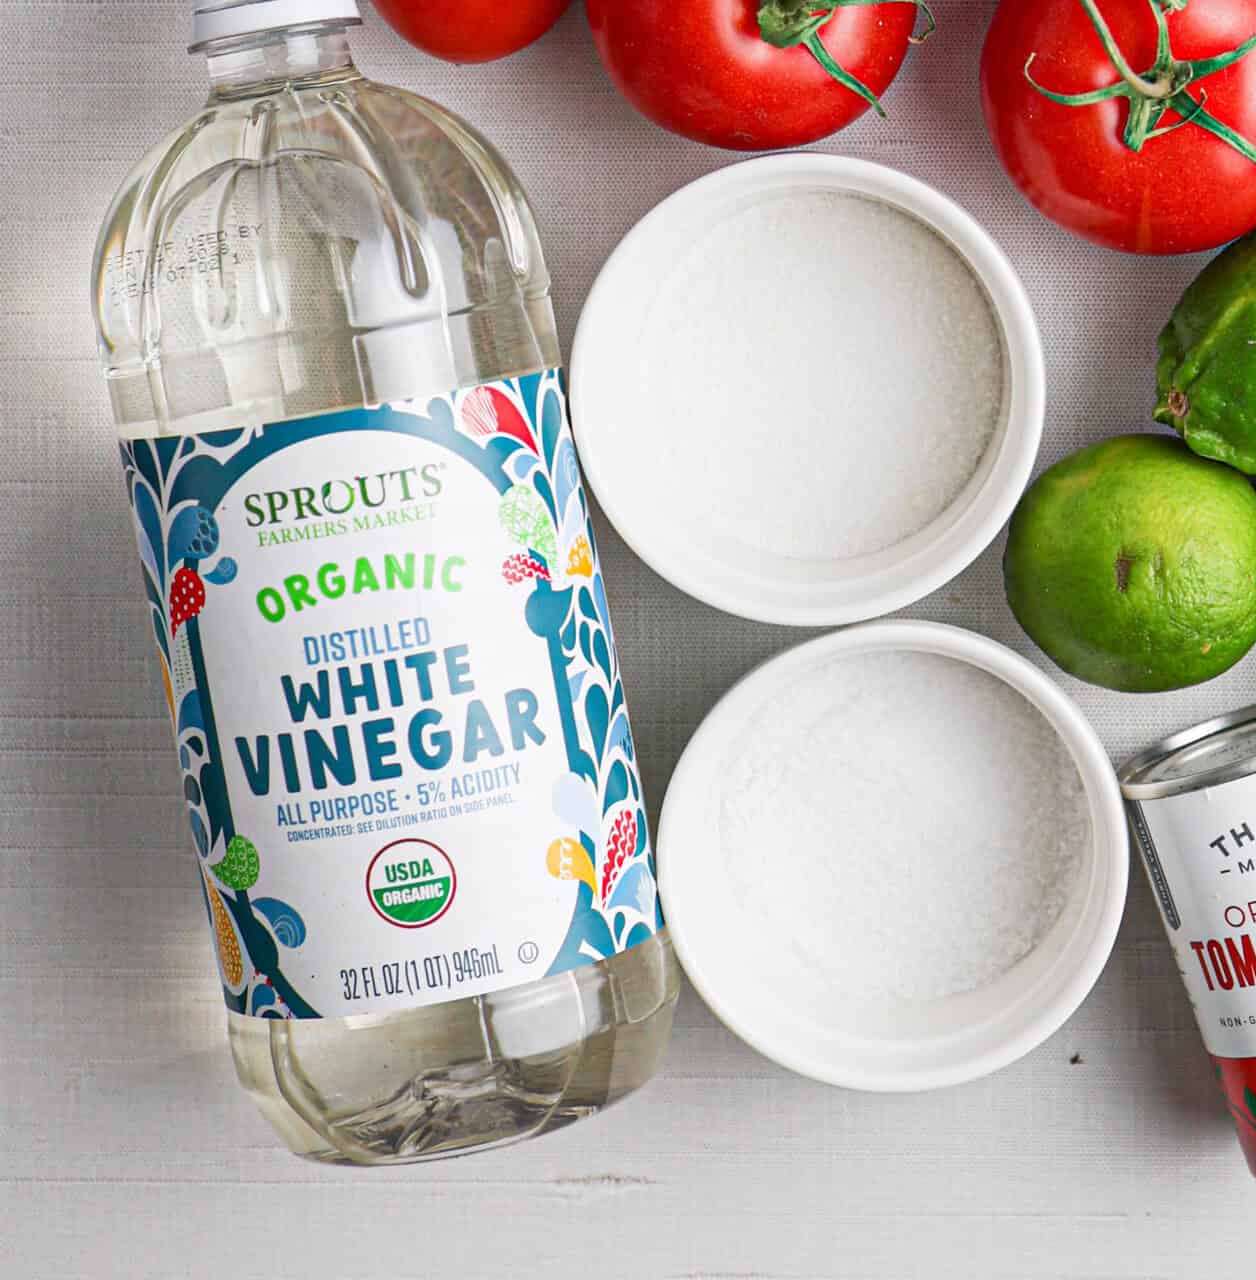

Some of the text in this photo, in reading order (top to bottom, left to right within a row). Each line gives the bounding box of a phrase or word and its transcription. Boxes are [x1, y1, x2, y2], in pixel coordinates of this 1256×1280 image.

[244, 463, 443, 527] SPROUTS
[257, 503, 436, 547] FARMERS MARKET
[256, 552, 466, 624] ORGANIC
[303, 617, 431, 665] DISTILLED
[281, 644, 475, 723] WHITE
[235, 688, 546, 796] VINEGAR
[277, 763, 521, 827] ALL PURPOSE 5% ACIDITY
[287, 825, 355, 842] CONCENTRATED:
[357, 821, 374, 834] SEE
[376, 814, 419, 831] DILUTION
[420, 809, 448, 824] RATIO
[449, 806, 463, 817] ON
[464, 801, 484, 815] SIDE
[383, 882, 444, 906] ORGANIC
[385, 859, 434, 883] USDA
[340, 944, 503, 1000] 32 FL OZ (1 QT) 946mL
